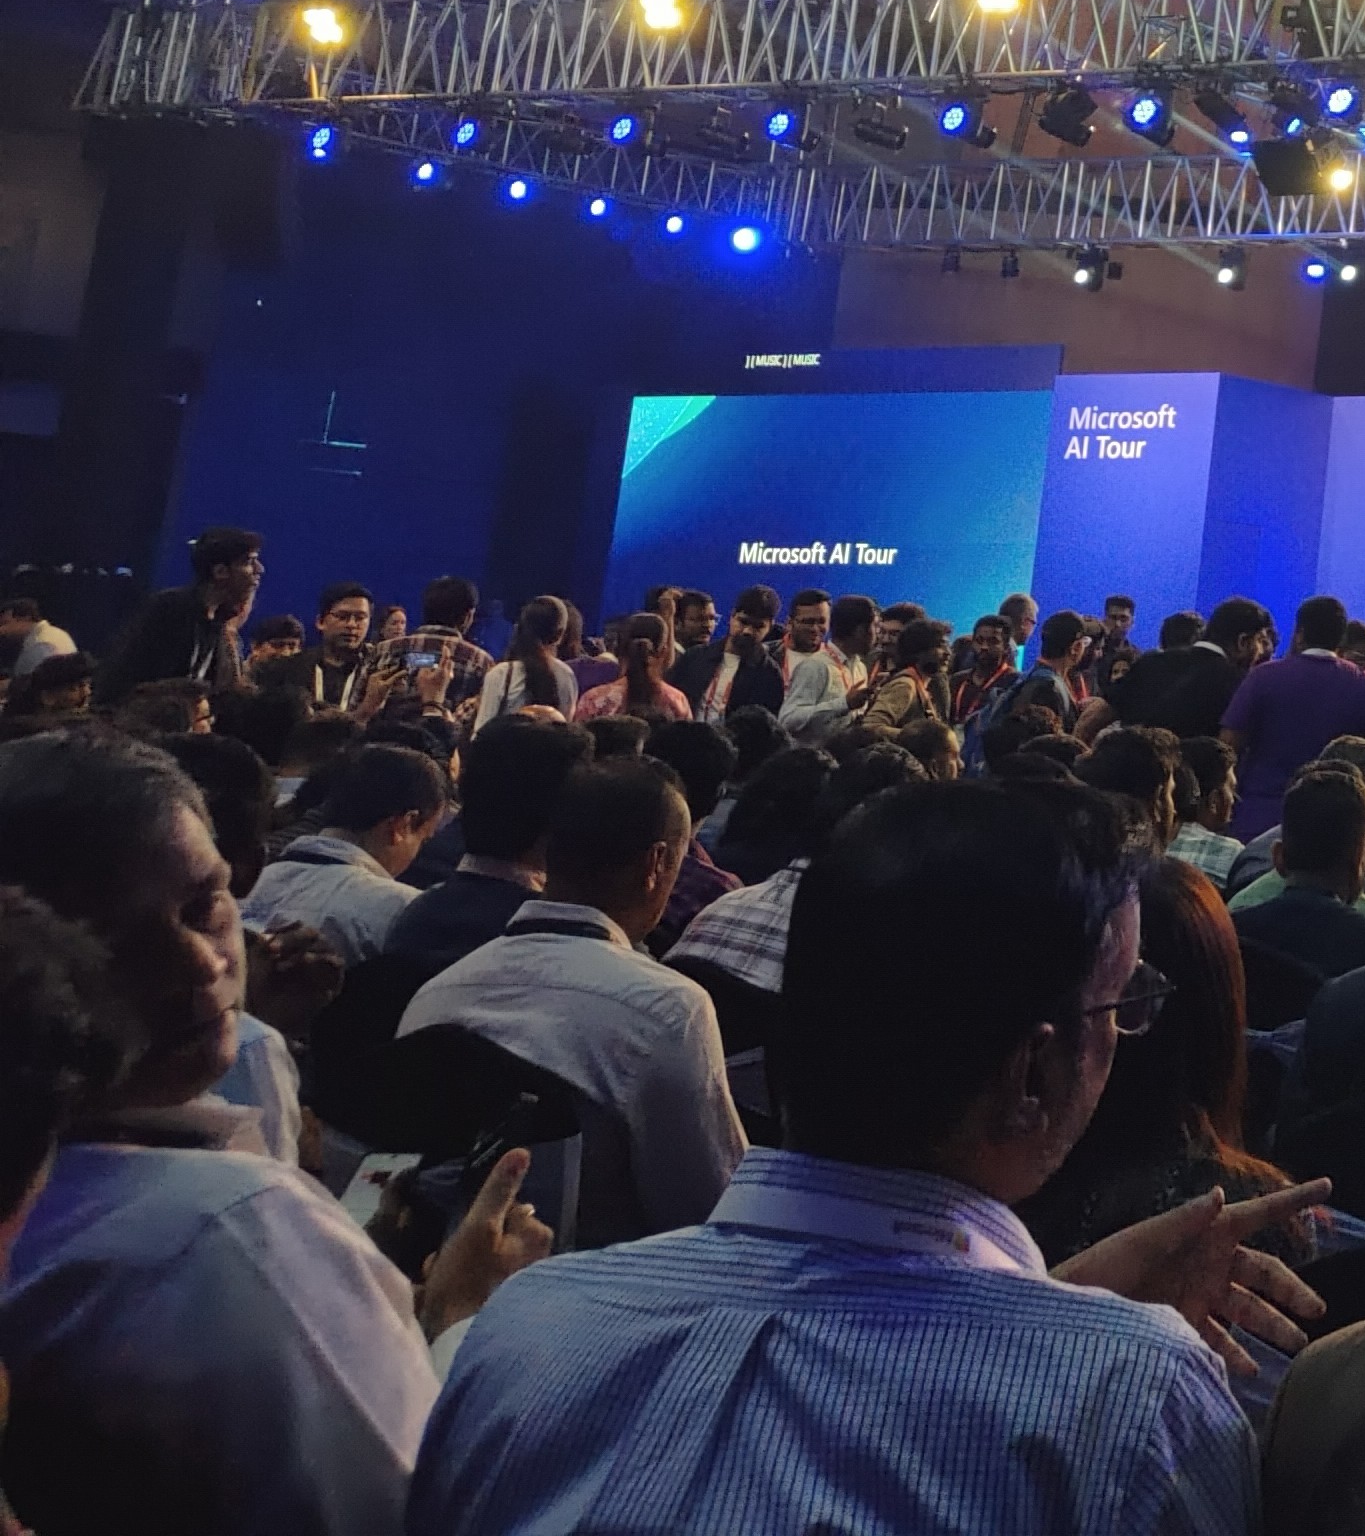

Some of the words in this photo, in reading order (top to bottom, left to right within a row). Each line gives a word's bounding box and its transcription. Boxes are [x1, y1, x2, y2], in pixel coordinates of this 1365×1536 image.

[1068, 403, 1177, 430] Microsoft
[1064, 435, 1090, 460] AI
[1096, 435, 1147, 460] Tour
[738, 541, 827, 566] Microsoft
[828, 542, 852, 566] AI
[855, 542, 899, 566] Tour
